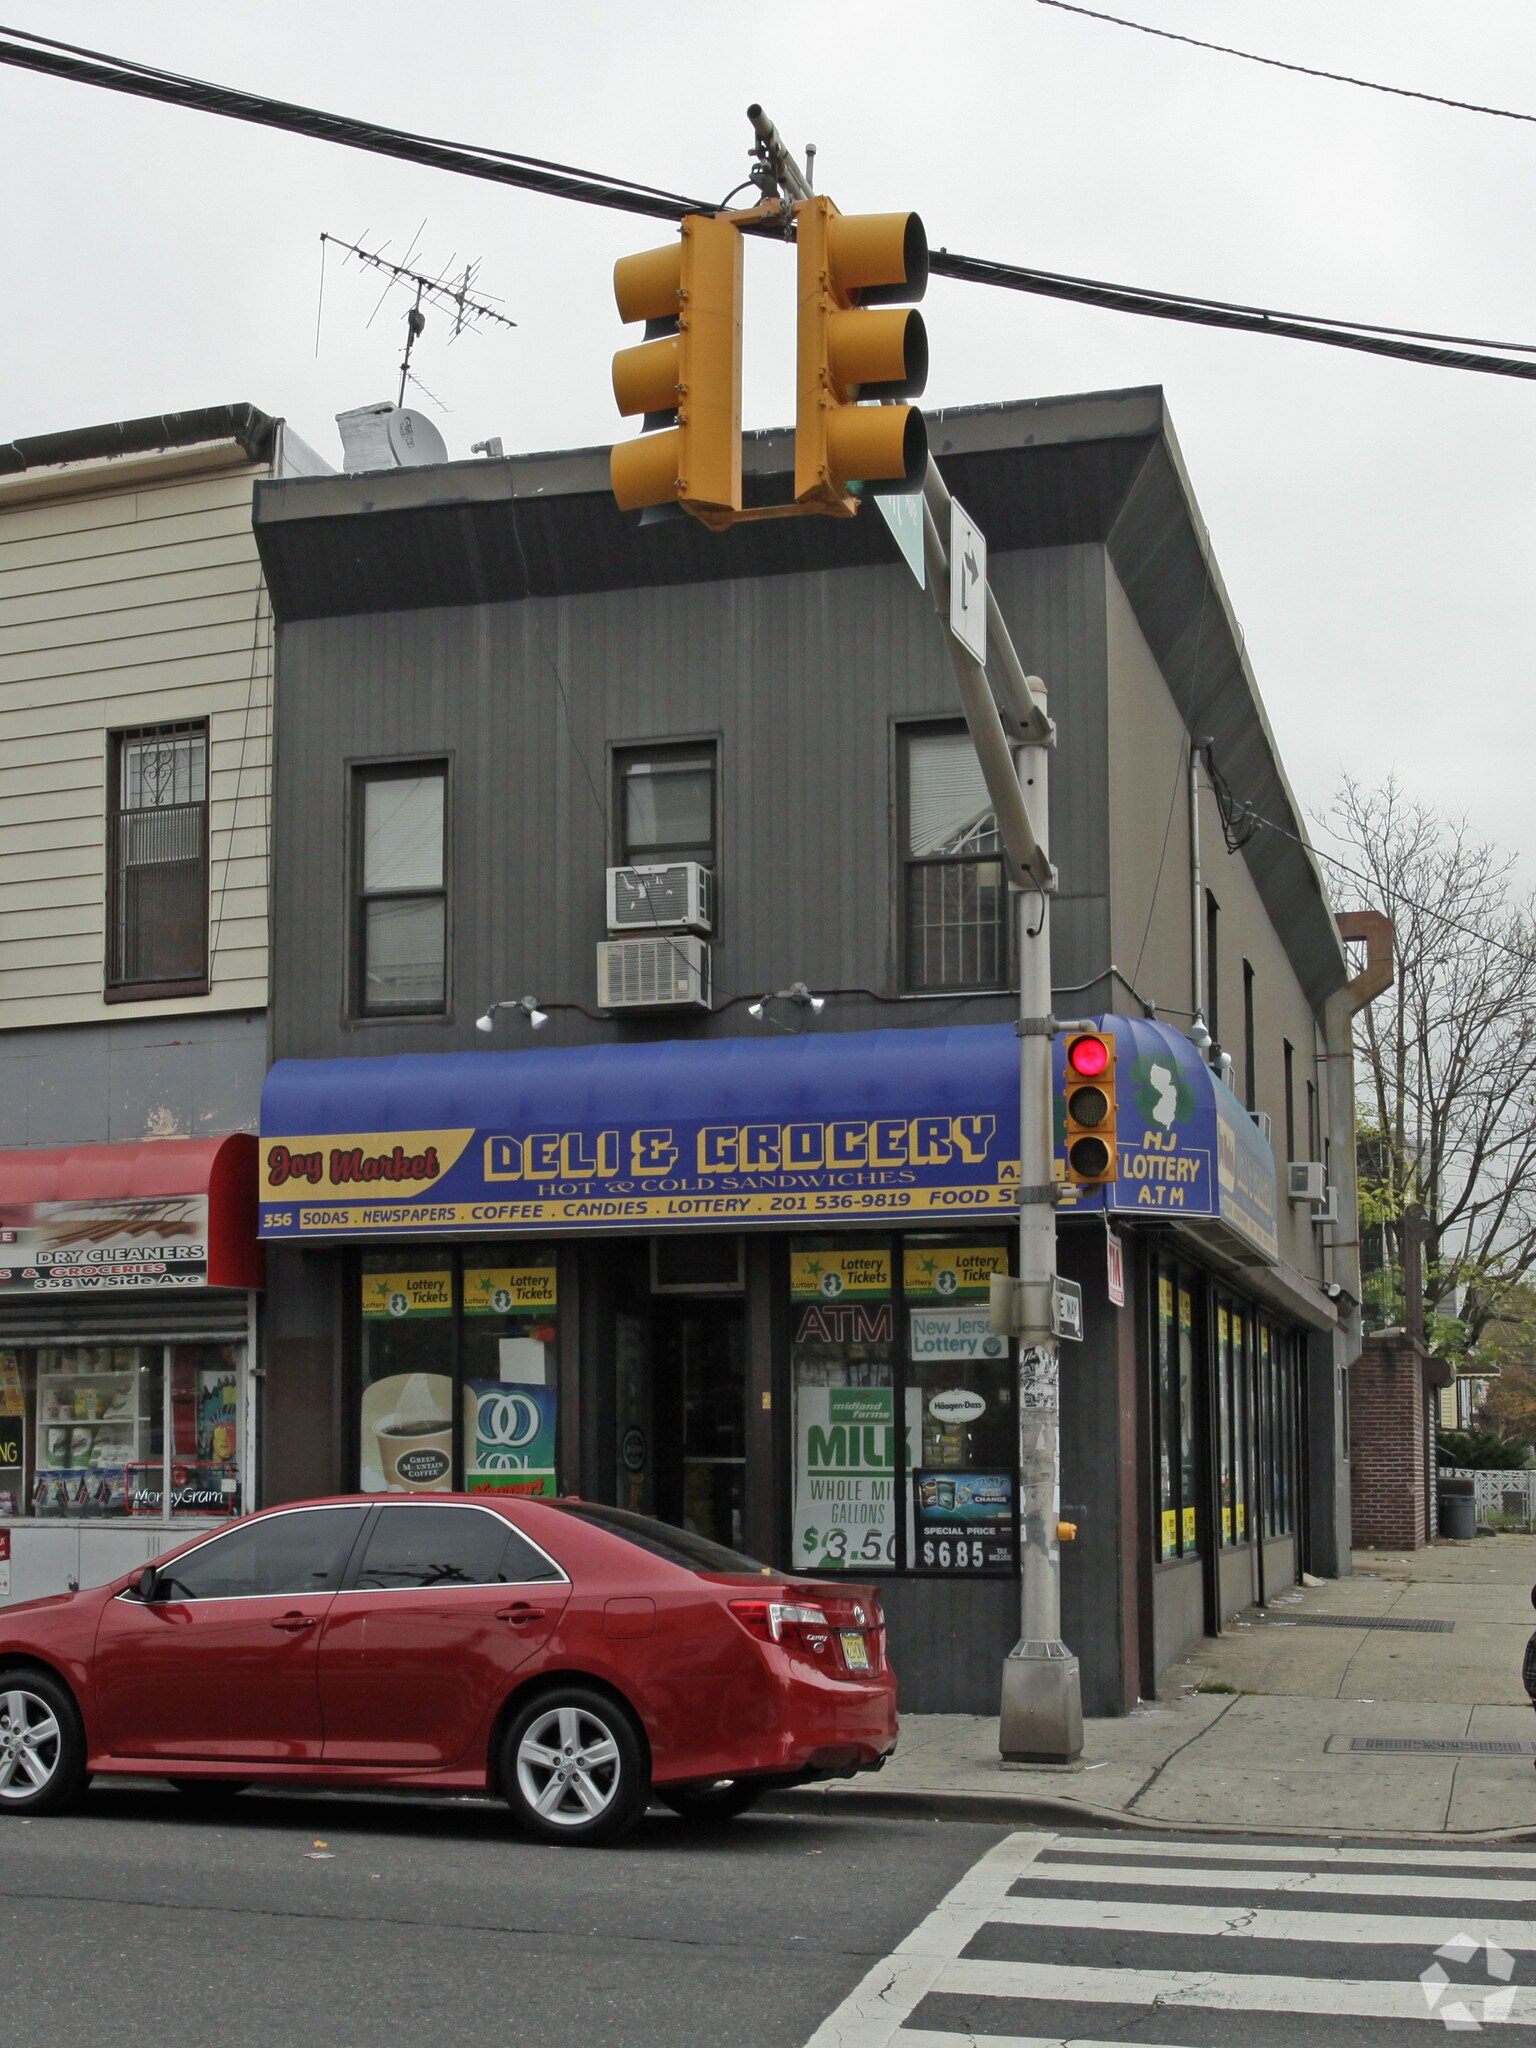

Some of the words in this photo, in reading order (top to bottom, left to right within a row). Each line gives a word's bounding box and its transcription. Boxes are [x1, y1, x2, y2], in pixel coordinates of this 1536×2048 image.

[484, 1130, 619, 1182] DELI
[631, 1129, 678, 1176] &
[697, 1114, 996, 1174] GROCERY
[1143, 1131, 1177, 1152] NJ
[268, 1145, 323, 1186] Joy
[329, 1146, 440, 1185] Market
[1123, 1153, 1200, 1182] LOTTERY
[538, 1182, 596, 1196] HOT
[605, 1181, 635, 1193] &
[641, 1178, 715, 1192] COLD
[721, 1170, 916, 1189] SANDWICHES
[303, 1211, 349, 1225] SODAS
[363, 1207, 456, 1224] NEWSPAPERS
[472, 1204, 544, 1219] COFFEE
[563, 1201, 648, 1217] CANDIES
[668, 1198, 751, 1214] LOTTERY
[770, 1196, 807, 1211] 201
[814, 1192, 911, 1209] 536-9819
[930, 1189, 990, 1205] FOOD
[263, 1214, 292, 1228] 356
[37, 1251, 83, 1265] DRY
[87, 1245, 204, 1262] CLEANERS
[956, 1256, 999, 1269] Lottery
[22, 1268, 39, 1279] &
[51, 1263, 167, 1277] GROCERIES
[841, 1258, 883, 1272] Lottery
[35, 1278, 73, 1290] 358
[80, 1277, 101, 1288] W
[107, 1275, 152, 1286] Side
[160, 1275, 200, 1285] Ave
[407, 1279, 445, 1291] Lottery
[510, 1275, 549, 1288] Lottery
[847, 1271, 887, 1284] Tickets
[412, 1291, 448, 1304] Tickets
[517, 1288, 553, 1300] Tickets
[796, 1304, 893, 1343] ATM
[913, 1319, 950, 1335] New
[955, 1317, 999, 1336] Jerse
[915, 1337, 977, 1355] Lottery
[833, 1402, 882, 1410] midland
[853, 1410, 890, 1419] farms
[808, 1425, 912, 1467] MILK
[402, 1462, 443, 1472] MUNTAIN
[409, 1455, 436, 1464] GREEN
[811, 1480, 862, 1500] WHOLE
[832, 1503, 885, 1524] GALLONS
[924, 1527, 963, 1535] SPECIAL
[967, 1527, 996, 1535] PRICE
